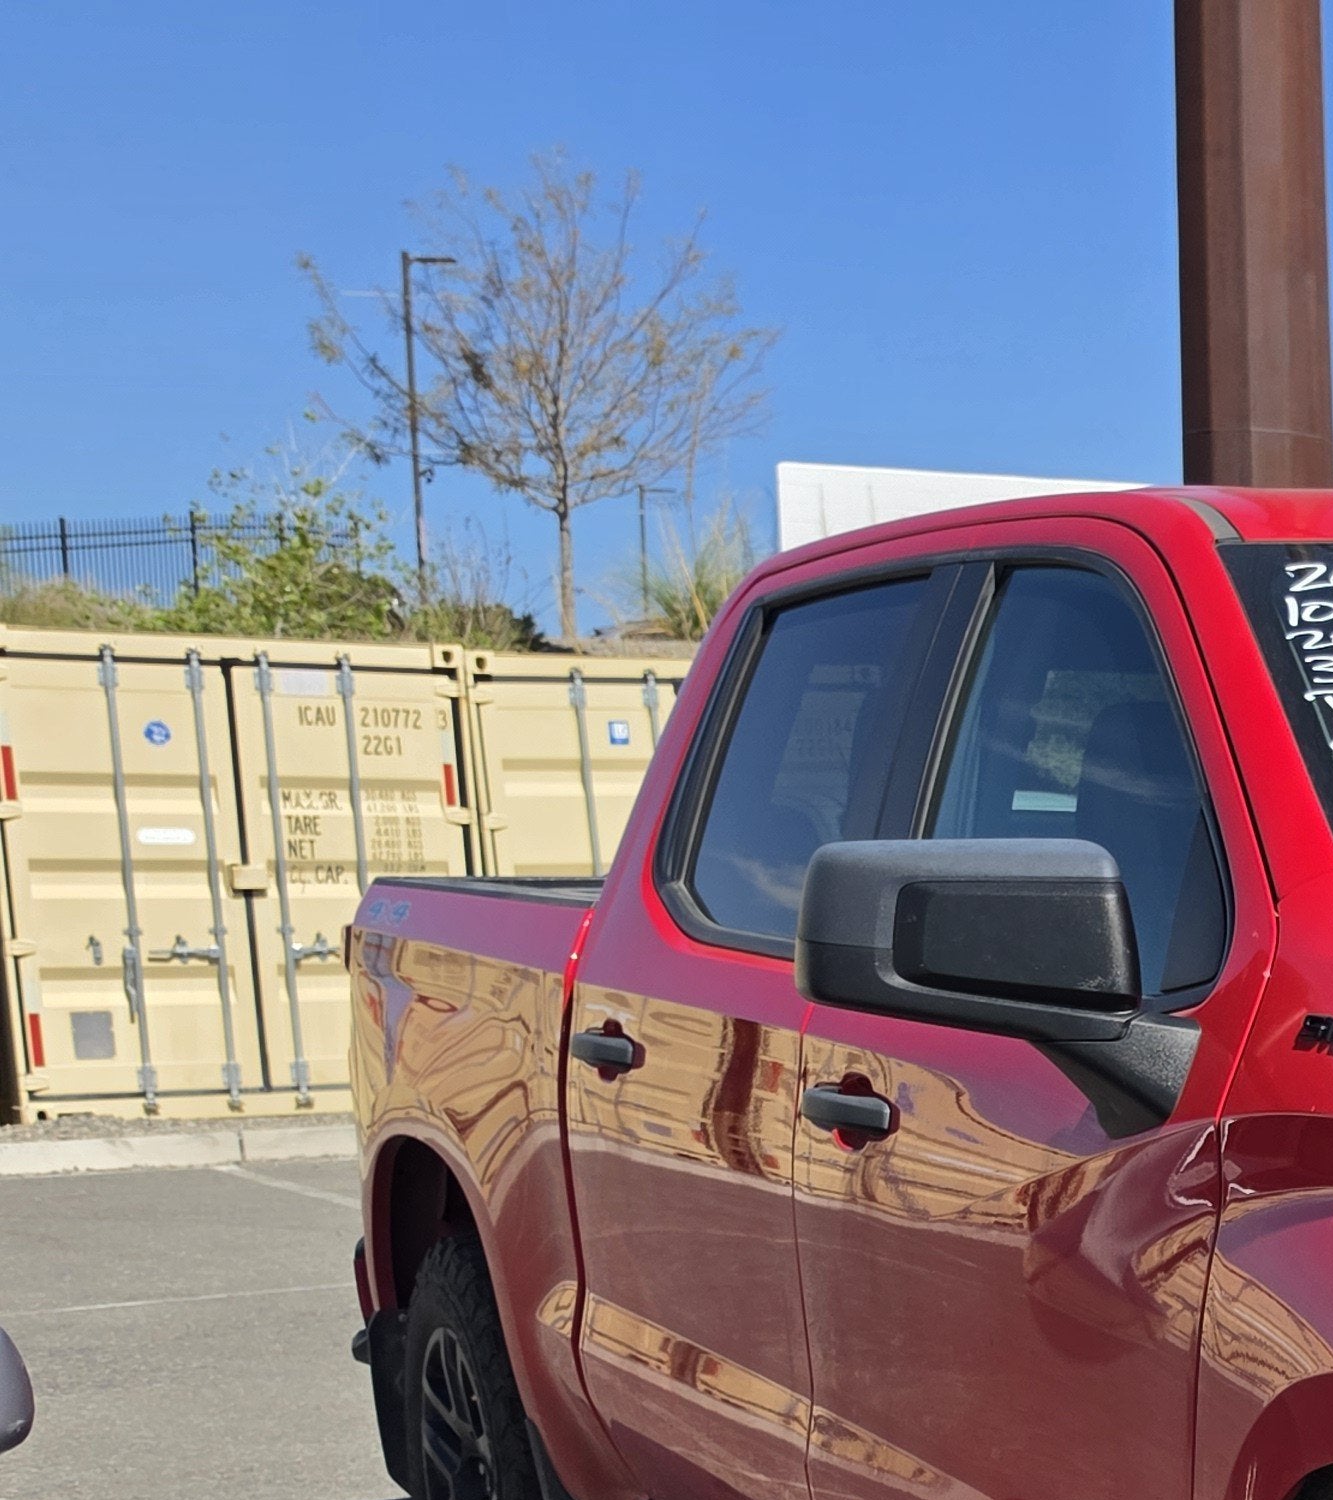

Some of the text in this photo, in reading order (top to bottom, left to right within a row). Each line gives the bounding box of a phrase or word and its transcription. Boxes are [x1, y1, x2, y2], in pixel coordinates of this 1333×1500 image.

[298, 705, 337, 727] ICAU
[359, 707, 423, 730] 210772
[362, 735, 403, 756] 22G1
[285, 815, 322, 836] TARE
[287, 839, 317, 860] NET
